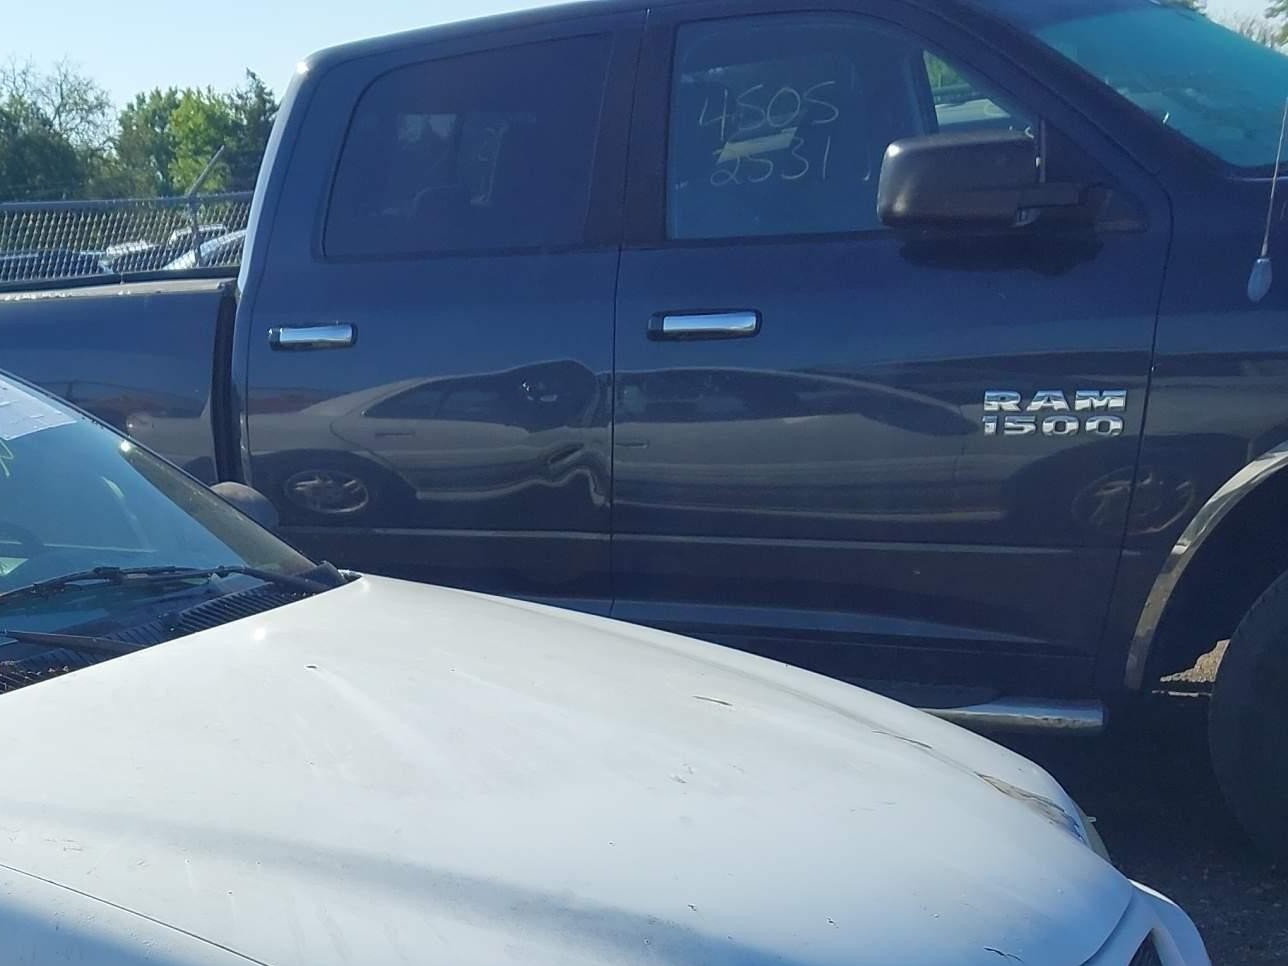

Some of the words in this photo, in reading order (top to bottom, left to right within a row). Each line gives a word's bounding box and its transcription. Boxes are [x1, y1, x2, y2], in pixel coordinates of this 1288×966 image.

[698, 79, 840, 143] 4505
[983, 389, 1128, 412] RAM
[982, 415, 1125, 437] 1500
